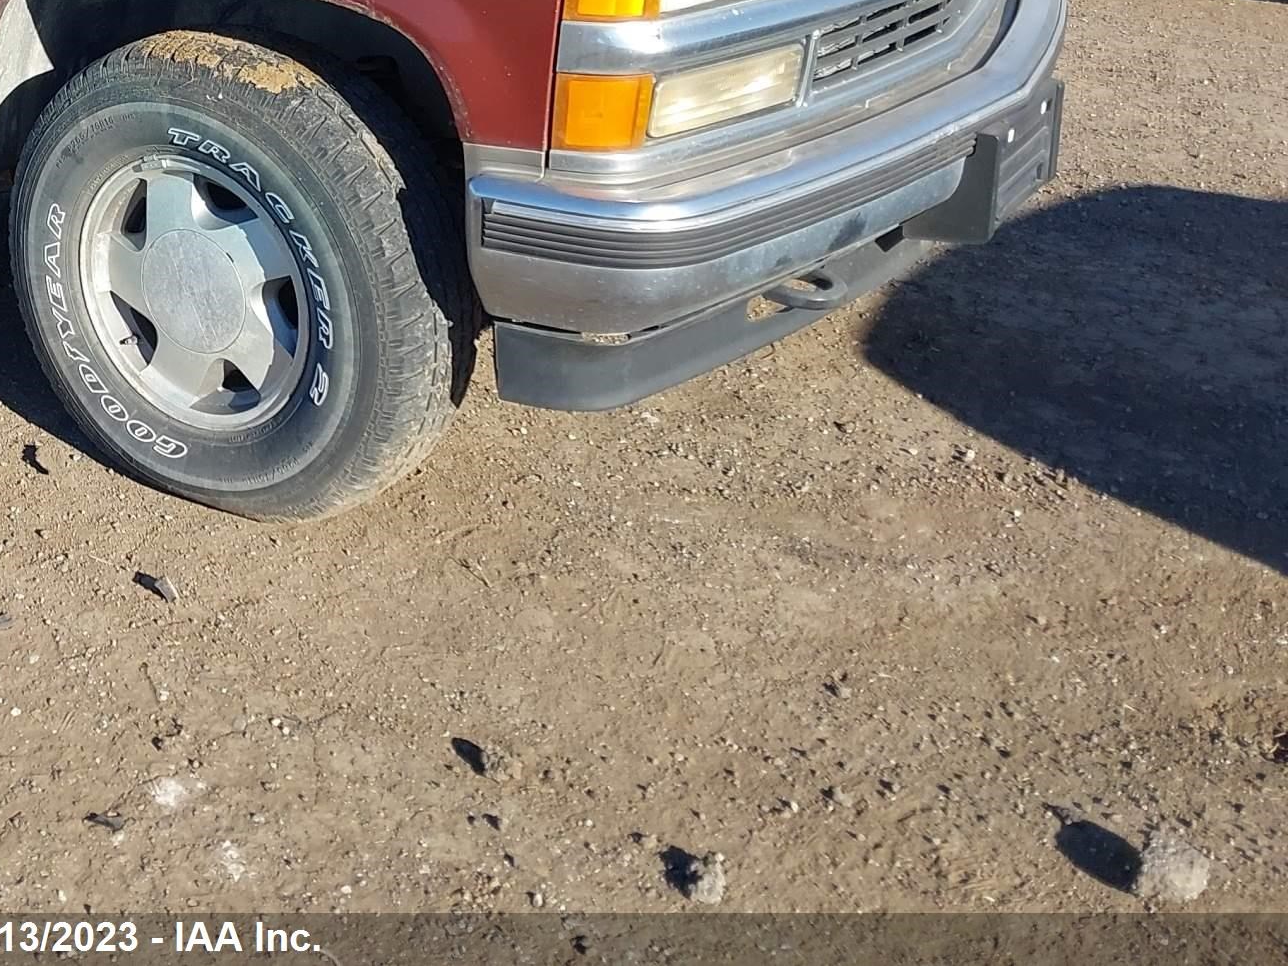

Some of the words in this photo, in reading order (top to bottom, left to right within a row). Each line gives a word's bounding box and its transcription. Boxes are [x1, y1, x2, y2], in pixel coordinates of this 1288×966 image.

[40, 202, 188, 460] GOODYEAR
[166, 126, 335, 352] TRACKER
[308, 361, 332, 408] 2
